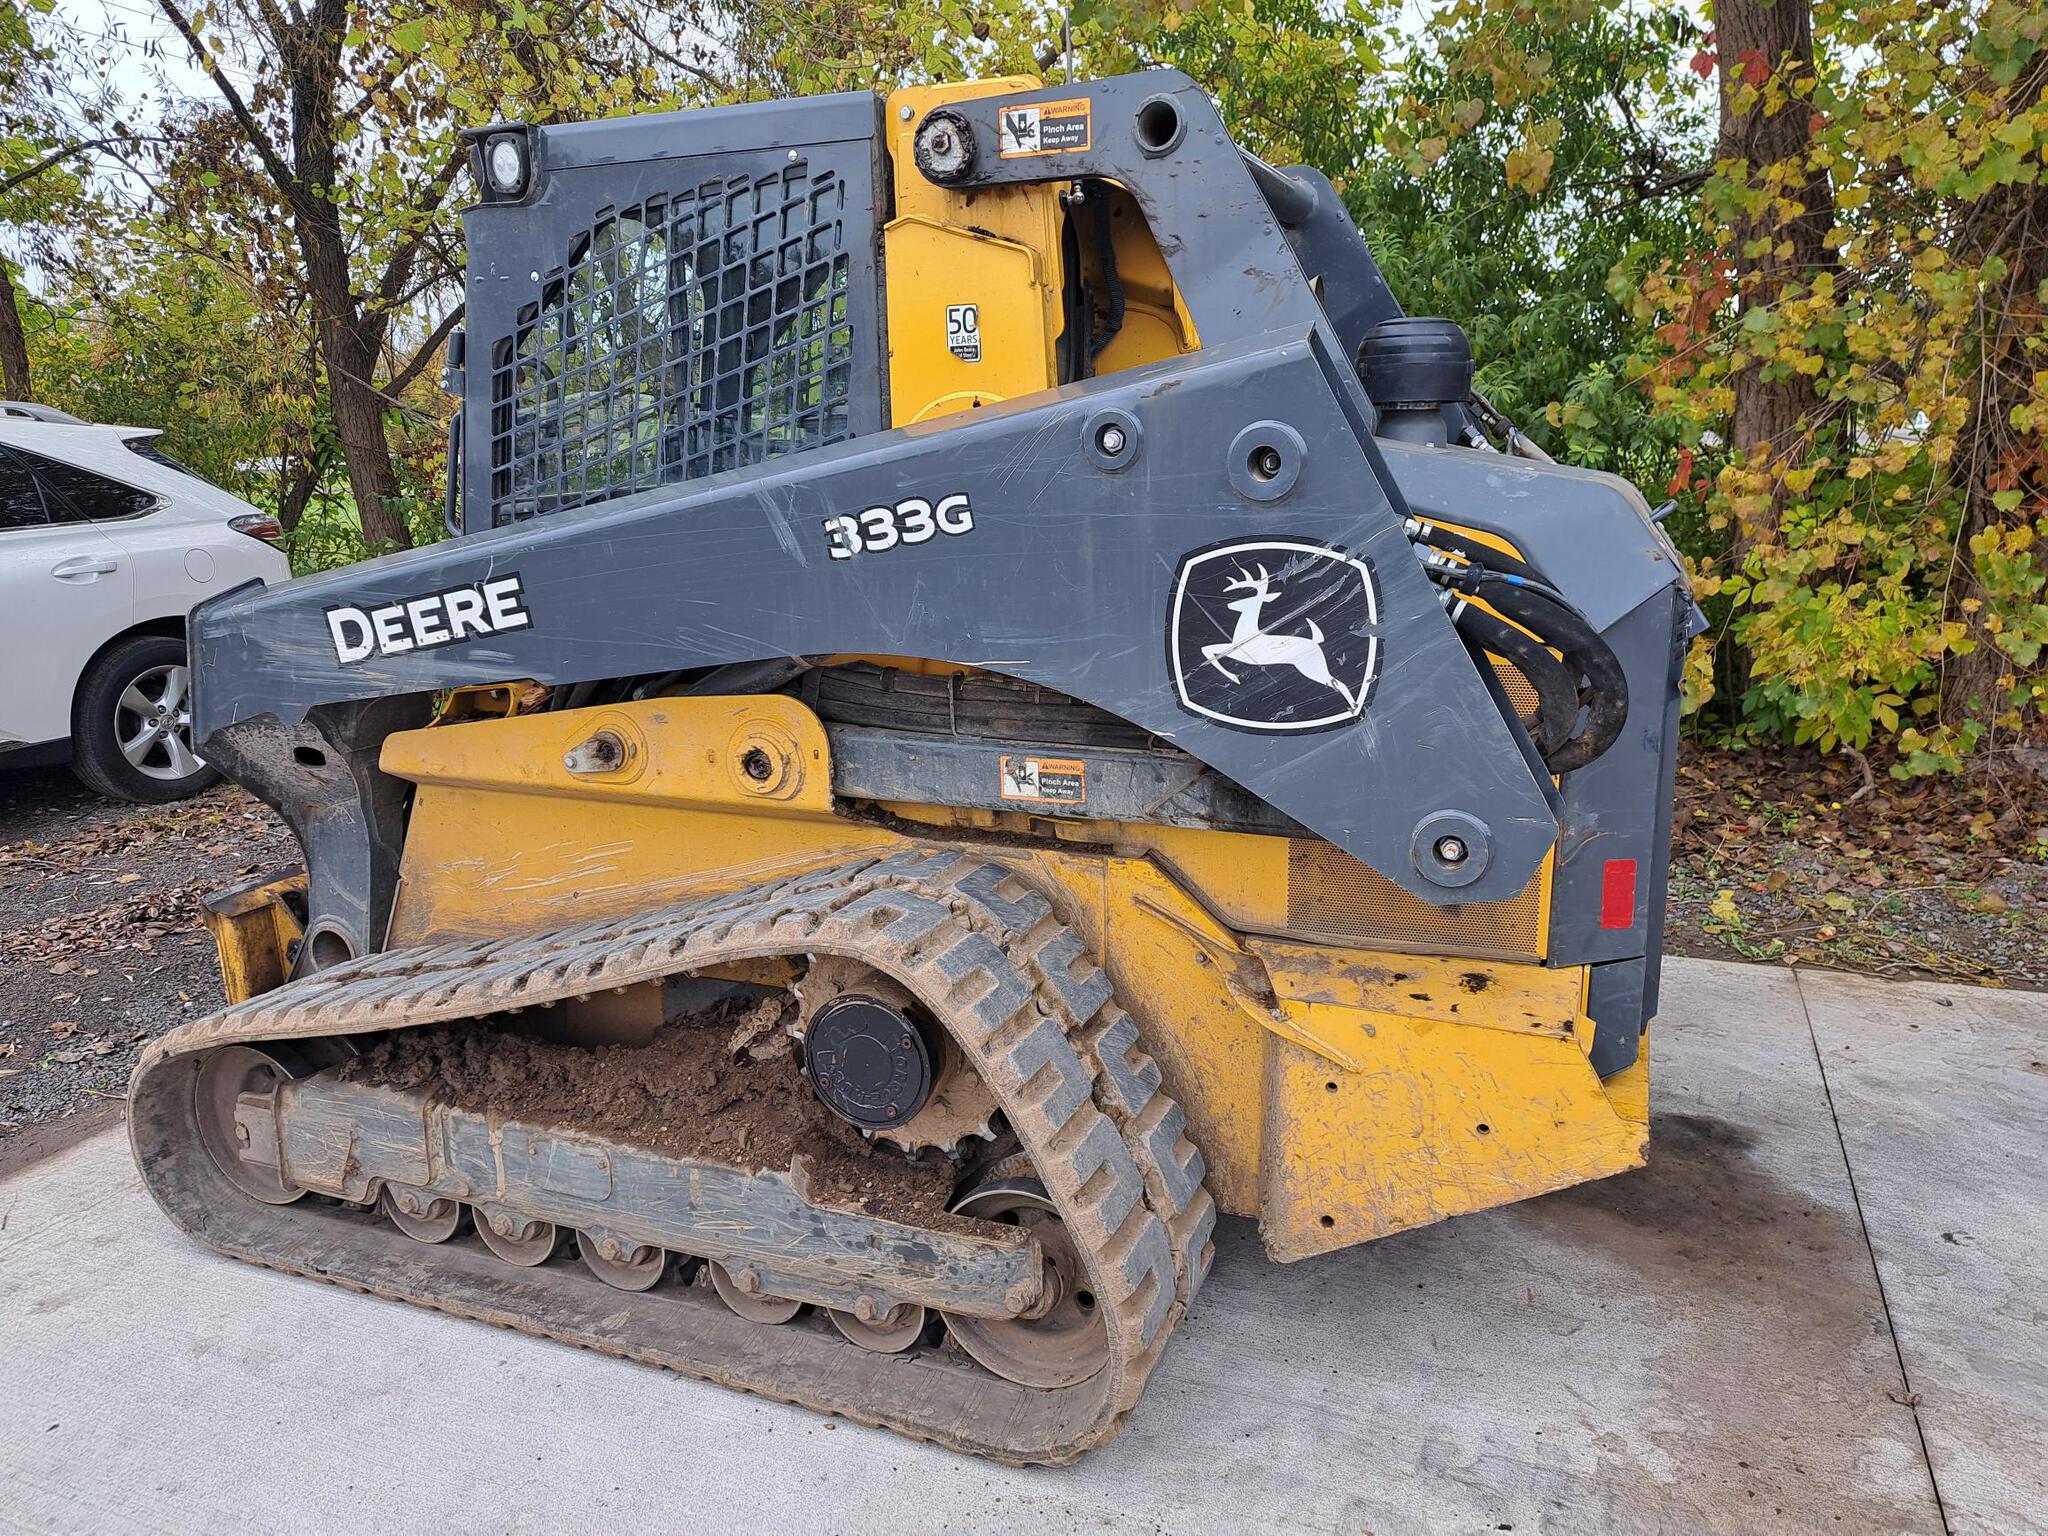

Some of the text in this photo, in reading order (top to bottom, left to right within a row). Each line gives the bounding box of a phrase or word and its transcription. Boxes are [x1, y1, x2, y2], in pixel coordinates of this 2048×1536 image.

[1051, 103, 1085, 113] WARNING
[1043, 123, 1084, 134] Pinch Area
[1061, 135, 1079, 143] Away
[949, 307, 977, 335] 50
[950, 335, 978, 344] YEARS
[825, 495, 973, 559] 333G
[326, 578, 528, 664] DEERE
[1048, 763, 1080, 772] WARNING
[1062, 779, 1080, 787] Area
[1058, 788, 1074, 796] Away
